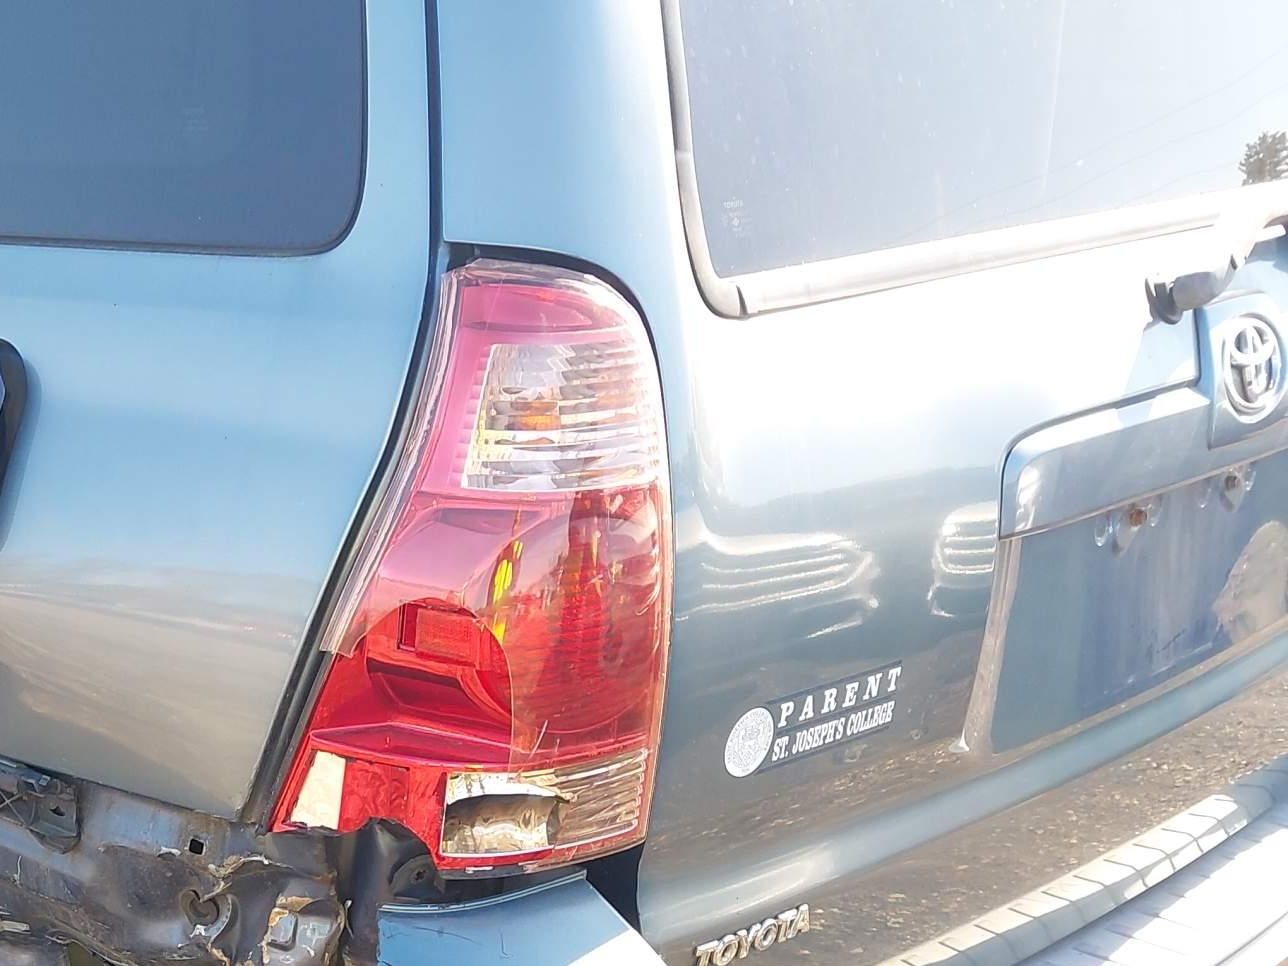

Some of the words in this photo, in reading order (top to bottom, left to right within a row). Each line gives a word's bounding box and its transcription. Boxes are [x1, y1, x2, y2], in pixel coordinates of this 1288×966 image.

[777, 666, 902, 728] PARENT
[771, 736, 789, 762] ST.
[792, 716, 844, 755] JOSEPH'S
[846, 700, 896, 736] COLLEGE
